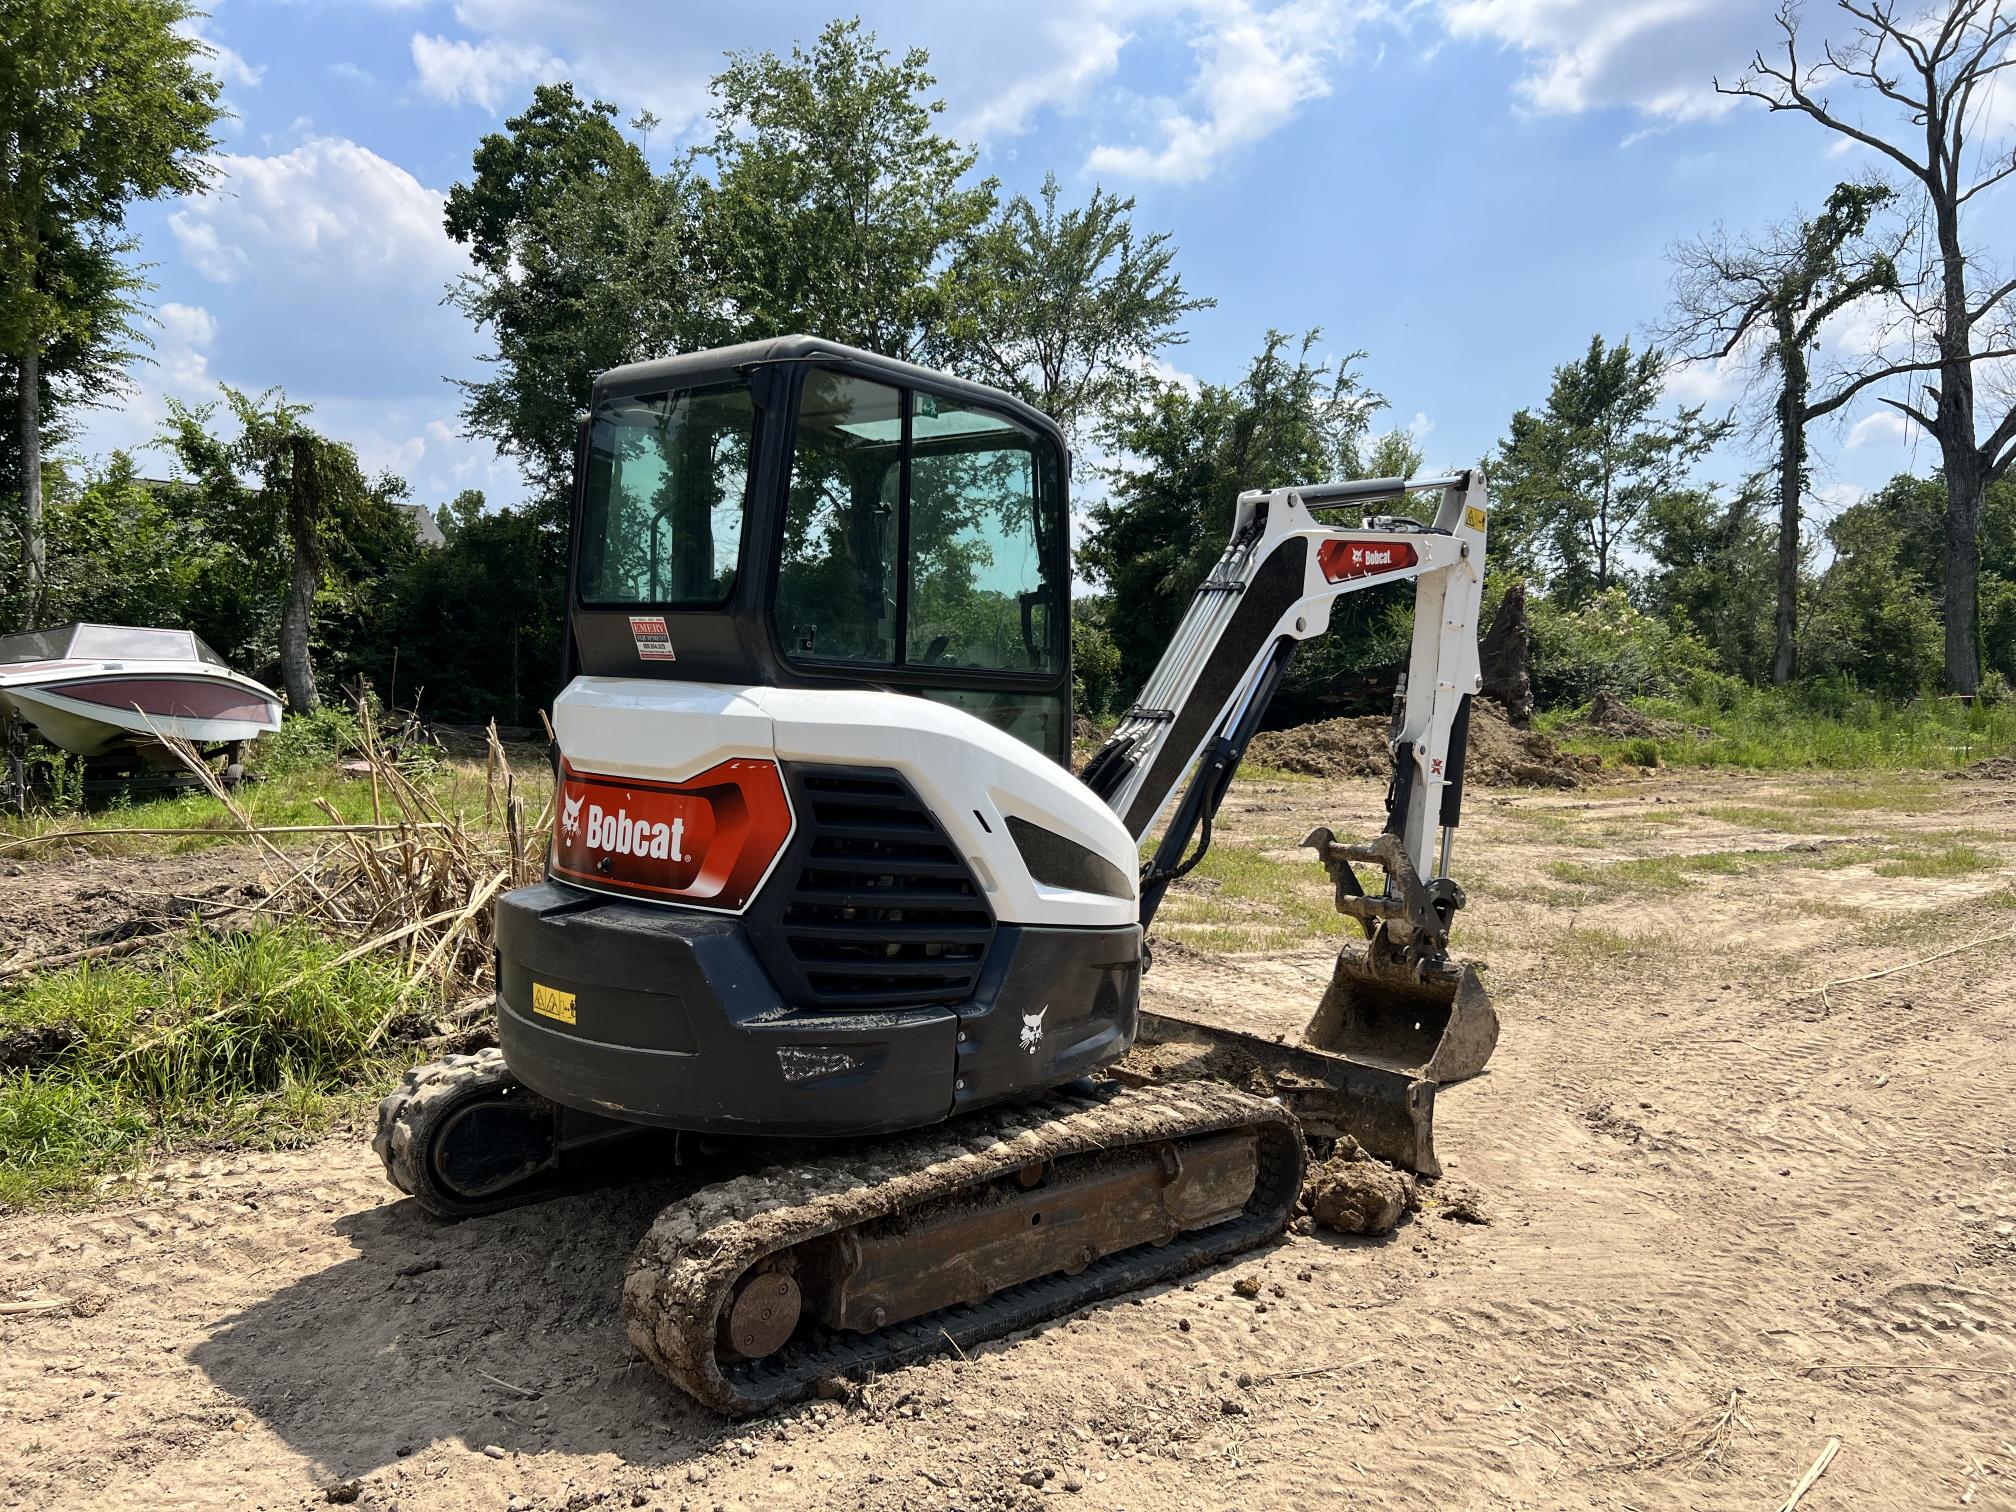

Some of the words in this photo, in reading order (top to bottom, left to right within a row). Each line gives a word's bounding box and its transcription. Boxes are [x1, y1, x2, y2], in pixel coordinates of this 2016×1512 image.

[1365, 550, 1391, 565] Bobcat
[634, 623, 664, 633] EMERY
[586, 804, 684, 862] Bobcat
